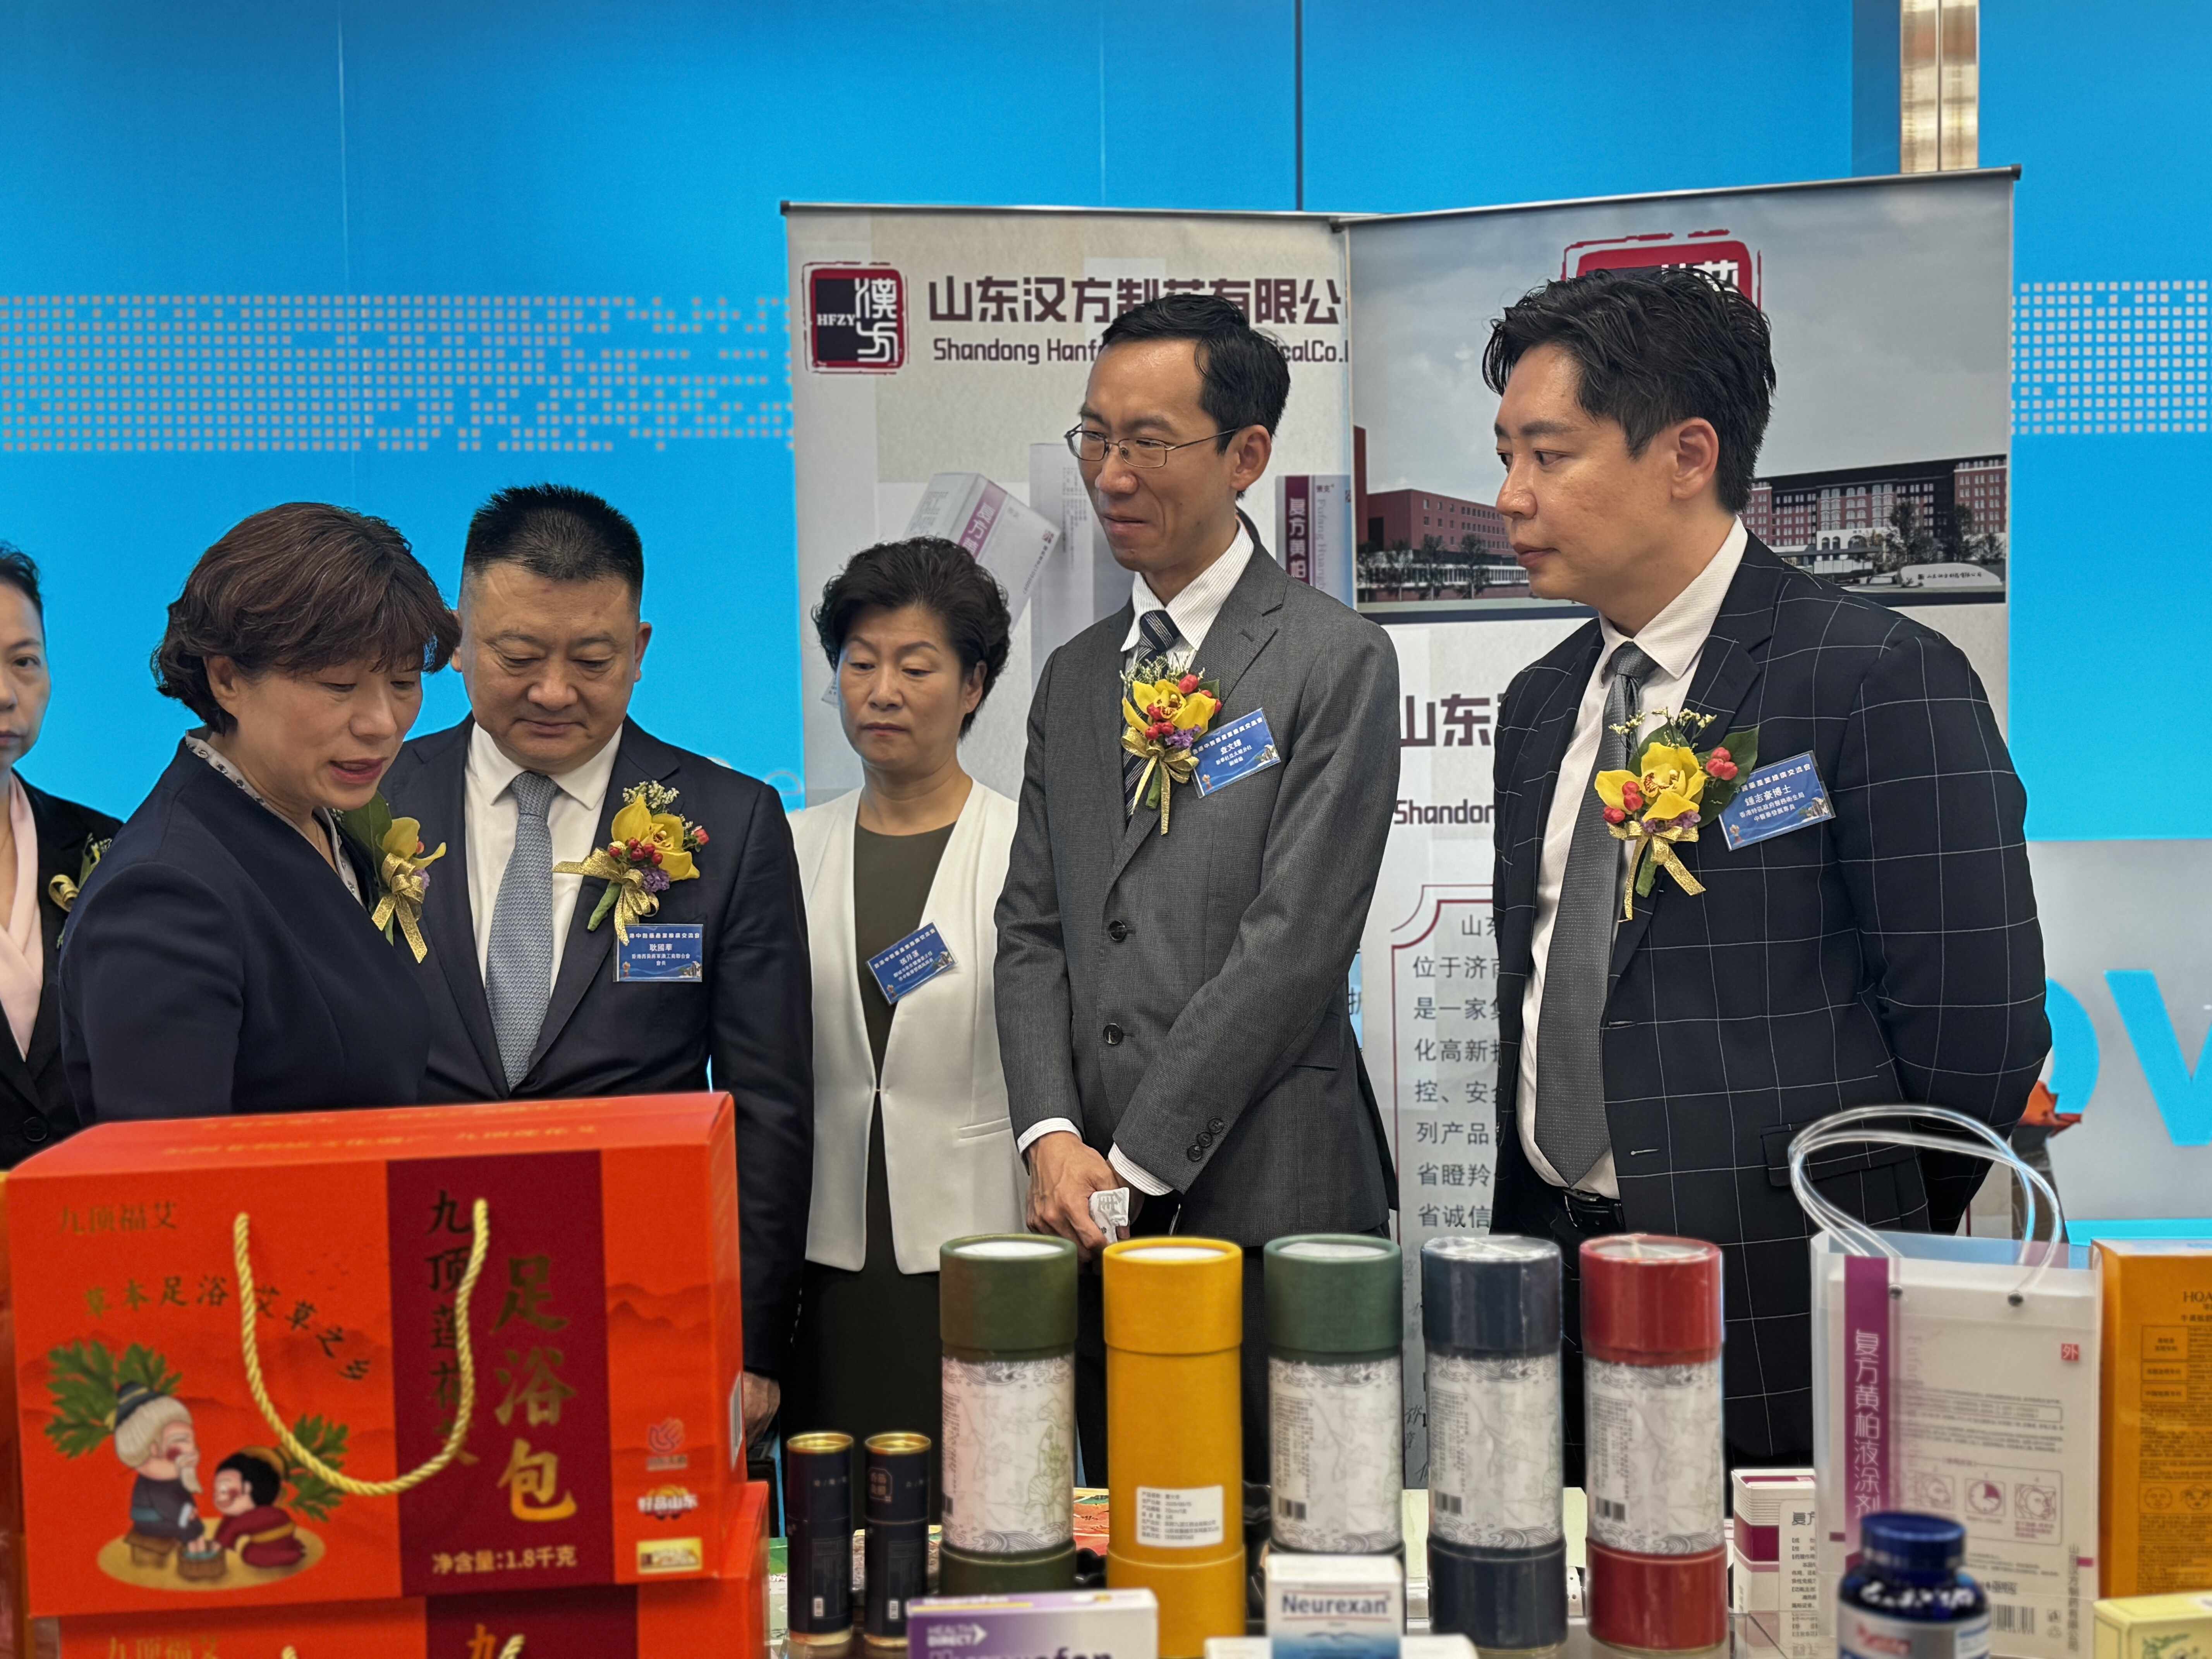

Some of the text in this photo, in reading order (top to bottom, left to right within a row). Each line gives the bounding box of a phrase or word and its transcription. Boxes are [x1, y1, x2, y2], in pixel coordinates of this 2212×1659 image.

[929, 275, 1348, 325] 山东汉方制有限公
[816, 313, 856, 327] HFZY
[933, 338, 1040, 365] Shandong
[1289, 498, 1307, 579] 复方黄柏
[1400, 694, 1505, 747] 山东
[1416, 1121, 1489, 1145] 列产品
[1417, 1162, 1491, 1187] 省瞪羚
[58, 1201, 177, 1234] 九顶福艾
[1418, 1203, 1491, 1228] 省诚信
[2063, 1345, 2078, 1360] 外
[489, 1254, 577, 1522] 足浴包
